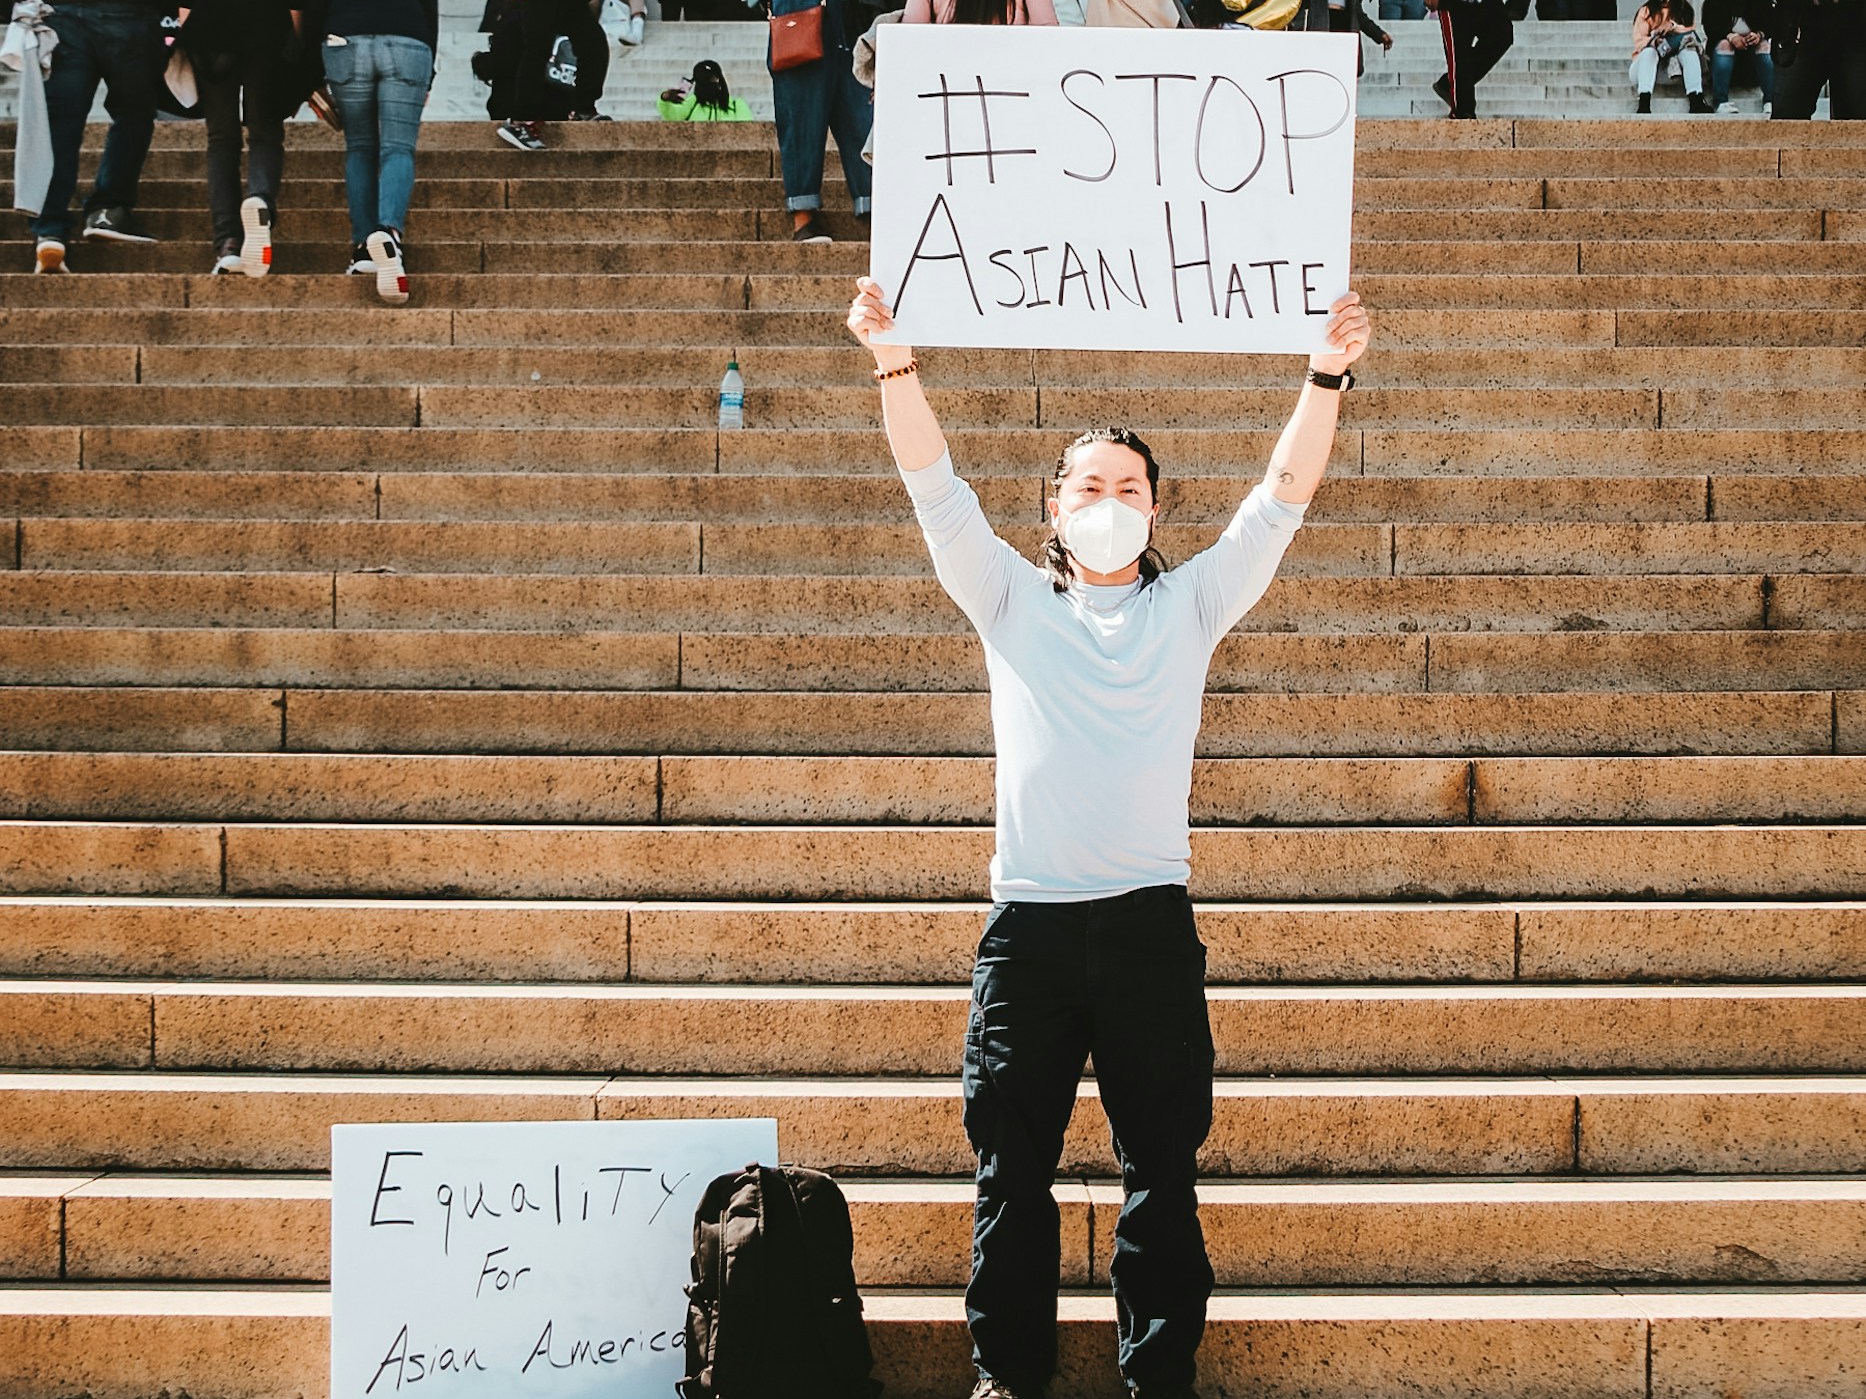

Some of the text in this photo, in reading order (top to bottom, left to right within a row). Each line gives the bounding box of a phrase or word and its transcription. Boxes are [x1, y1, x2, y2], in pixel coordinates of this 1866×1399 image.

[917, 69, 1350, 195] #STOP
[892, 193, 1329, 323] ASIAN HATE
[475, 1246, 532, 1299] For
[365, 1324, 488, 1395] Asian
